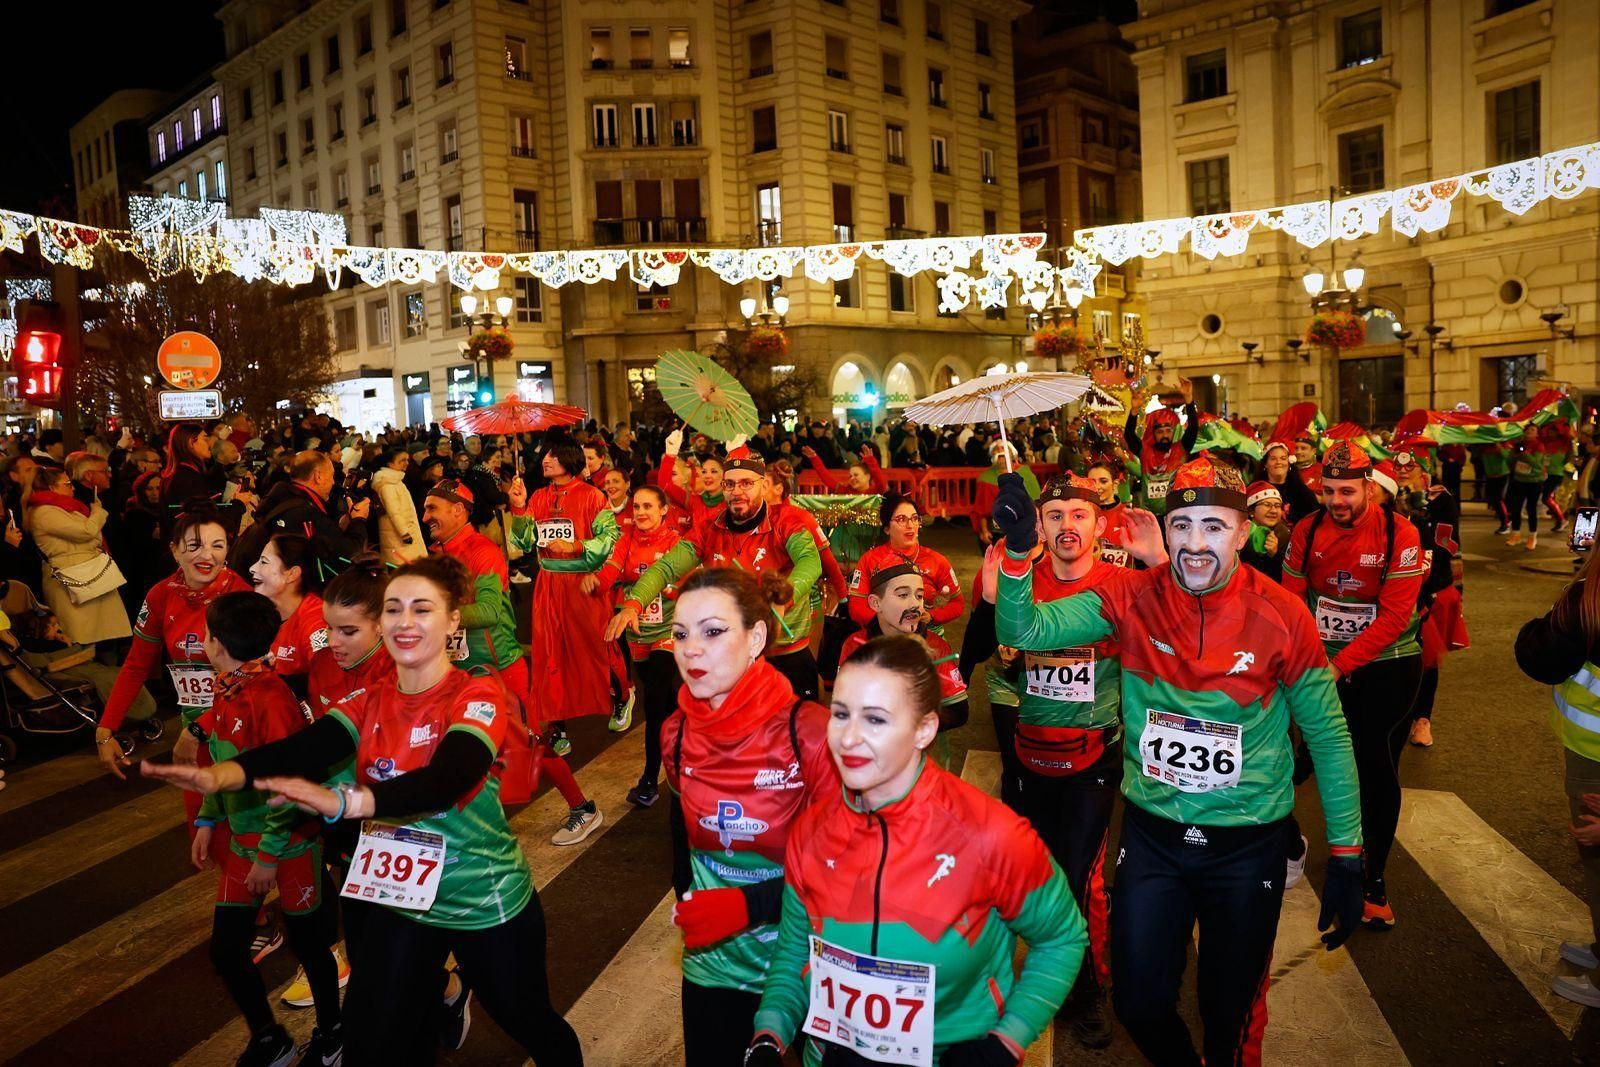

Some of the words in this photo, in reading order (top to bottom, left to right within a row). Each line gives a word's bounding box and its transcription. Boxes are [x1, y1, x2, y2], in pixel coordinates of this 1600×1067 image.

[541, 528, 572, 539] 1269
[1030, 664, 1090, 685] 1704
[1148, 737, 1235, 775] 1236
[360, 848, 439, 886] 1397
[820, 976, 925, 1033] 1707
